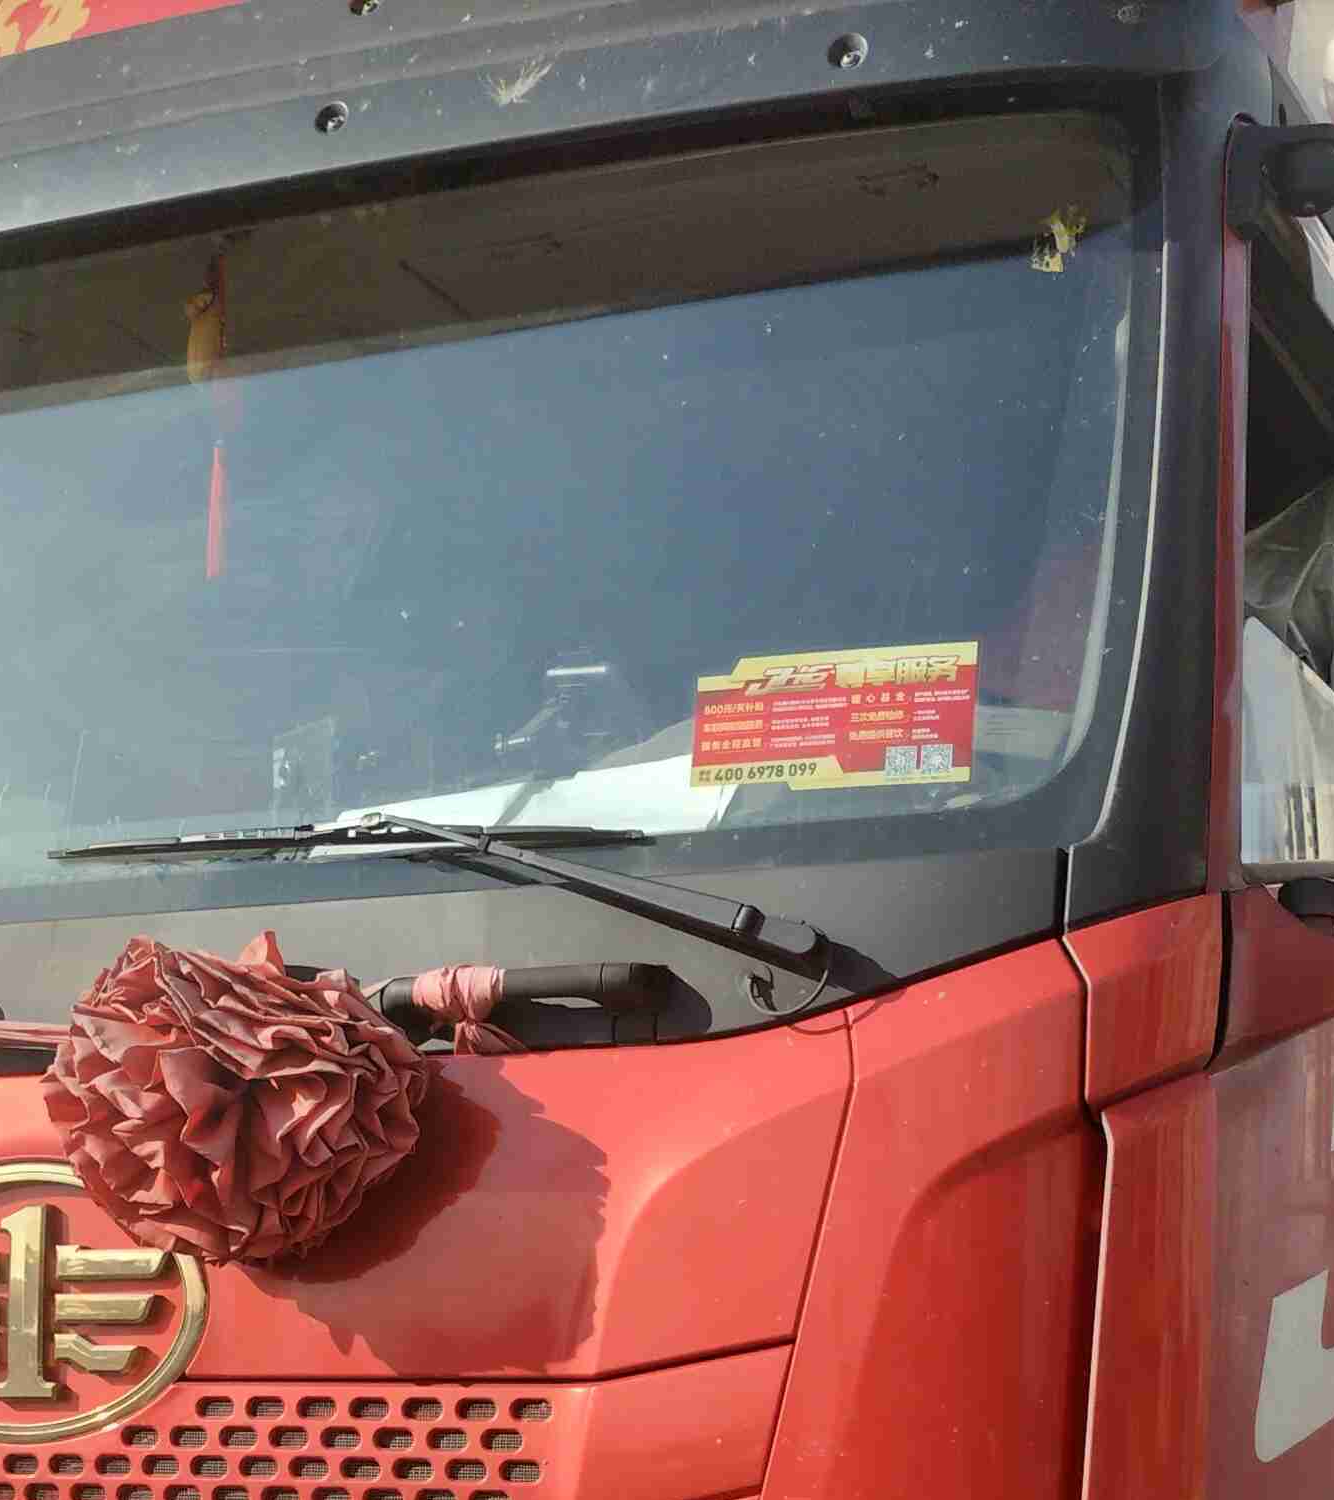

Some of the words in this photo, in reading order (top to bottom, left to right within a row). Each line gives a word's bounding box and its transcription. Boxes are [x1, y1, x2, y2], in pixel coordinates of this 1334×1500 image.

[714, 767, 744, 782] 400
[747, 764, 784, 780] 6978
[788, 762, 818, 777] 099
